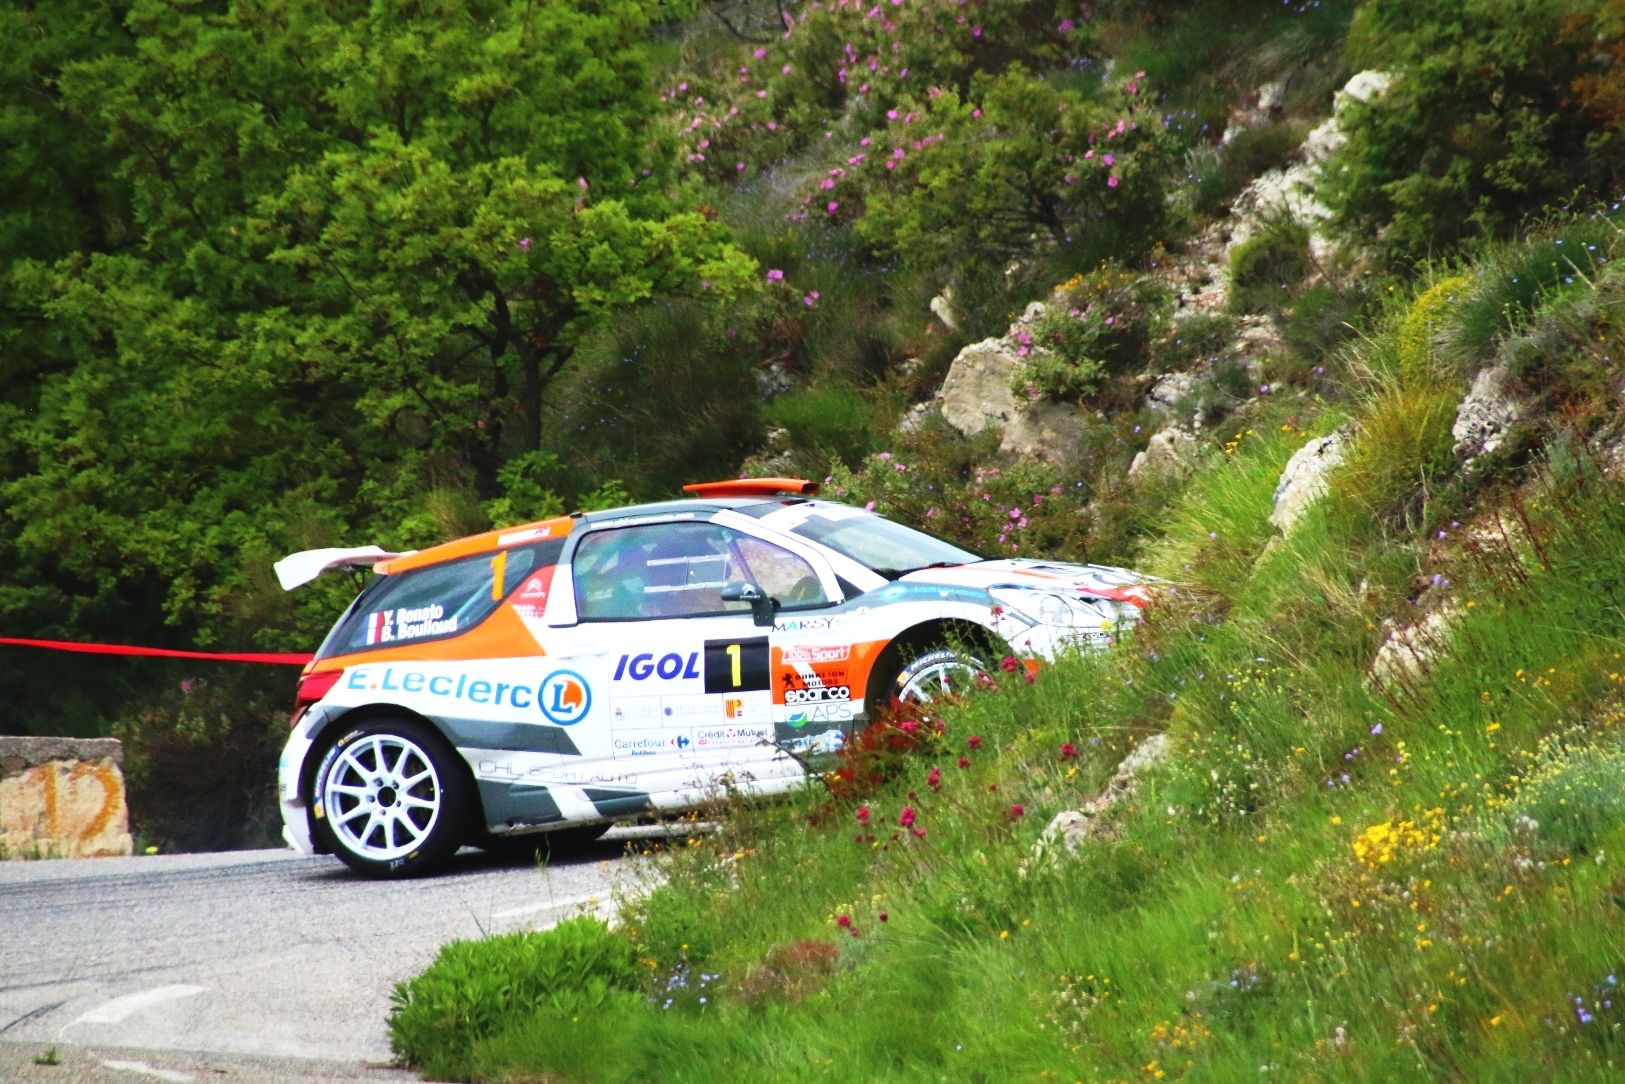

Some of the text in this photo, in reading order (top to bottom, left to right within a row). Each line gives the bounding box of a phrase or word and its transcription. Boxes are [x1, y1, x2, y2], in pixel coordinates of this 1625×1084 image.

[490, 551, 508, 601] 1
[396, 603, 444, 624] Bonato
[397, 615, 458, 640] Boulloud
[771, 616, 835, 633] MARSY
[811, 647, 845, 661] Sport
[613, 651, 701, 681] IGOL
[726, 644, 742, 687] 1
[347, 667, 532, 708] E.Leclerc
[785, 686, 850, 705] sparco
[811, 703, 852, 722] APS
[614, 737, 667, 749] Carrefour
[697, 729, 725, 739] Crédit
